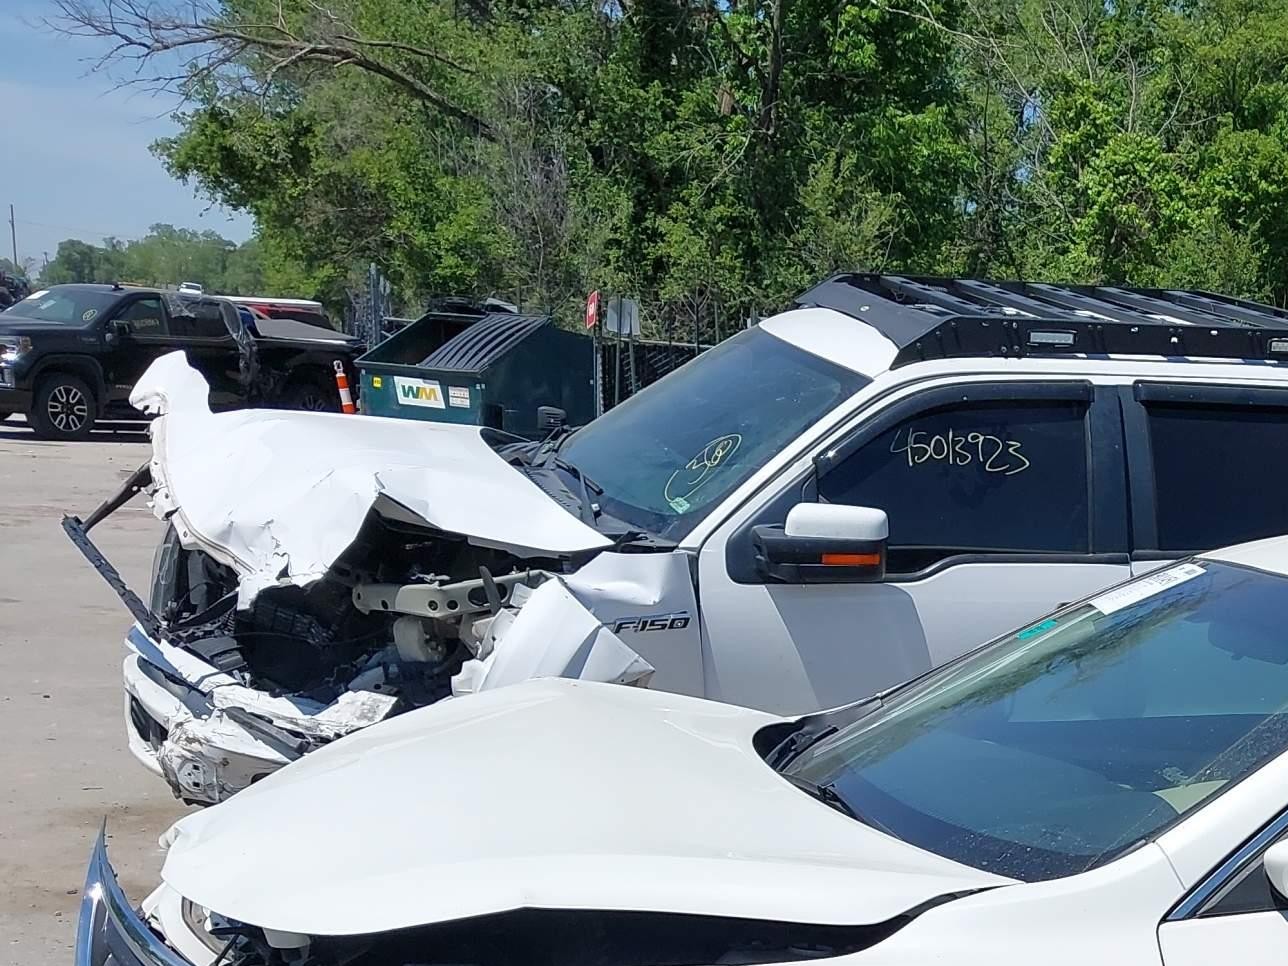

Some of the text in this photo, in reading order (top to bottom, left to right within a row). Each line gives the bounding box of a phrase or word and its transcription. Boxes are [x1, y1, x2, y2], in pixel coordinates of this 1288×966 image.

[401, 384, 439, 401] WM
[890, 428, 1030, 475] 45013923
[614, 617, 691, 634] F-150
